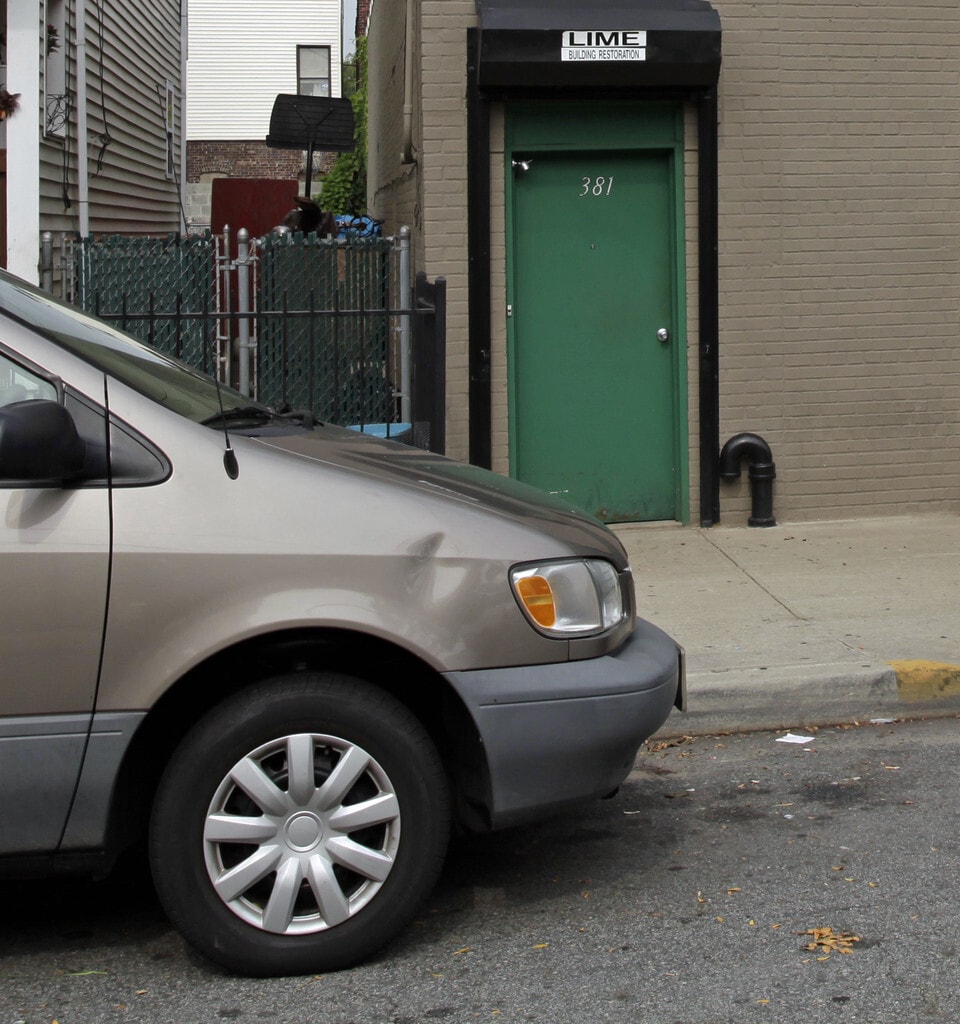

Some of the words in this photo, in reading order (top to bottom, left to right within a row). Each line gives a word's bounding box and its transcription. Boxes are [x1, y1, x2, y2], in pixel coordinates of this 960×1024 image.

[569, 31, 639, 46] LIME
[569, 50, 596, 60] BUILDING
[599, 50, 639, 60] RESTORATION
[578, 175, 614, 197] 381
